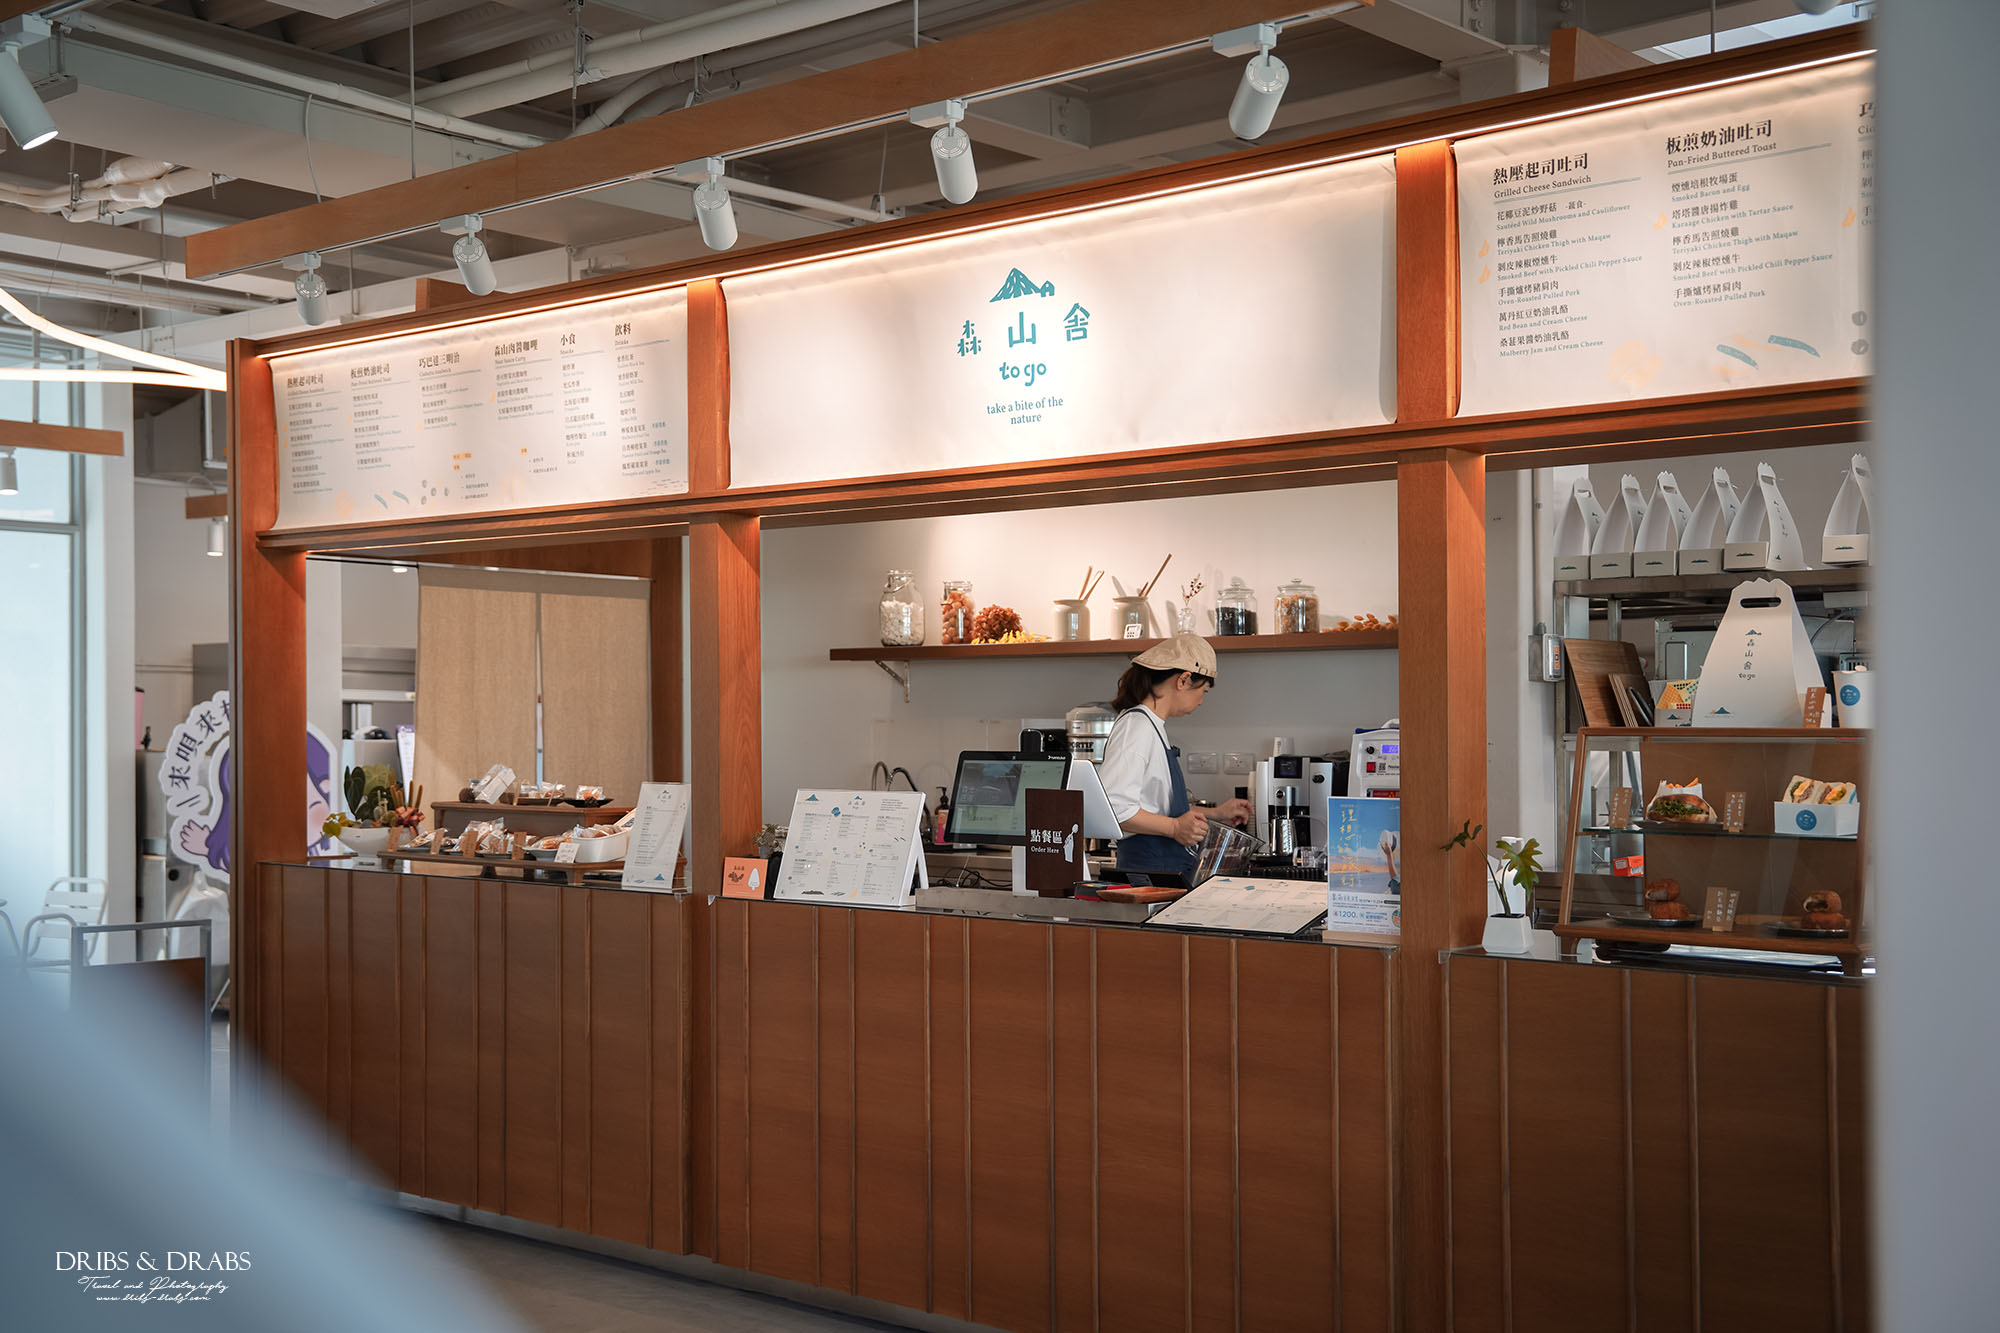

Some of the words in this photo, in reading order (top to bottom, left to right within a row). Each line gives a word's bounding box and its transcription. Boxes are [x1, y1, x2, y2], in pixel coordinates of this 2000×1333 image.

[1666, 120, 1772, 155] 板煎奶油吐司
[1668, 153, 1709, 168] Pan-Fried
[1712, 146, 1750, 160] Buttered
[1752, 142, 1777, 152] Toast
[1493, 153, 1588, 185] 熱壓起司吐司
[1494, 187, 1521, 198] Grilled
[1523, 183, 1550, 194] Cheese
[1552, 175, 1592, 189] Sandwich
[1671, 172, 1738, 193] 煙燻培根牧場蛋
[1672, 192, 1698, 202] Smoked
[1700, 189, 1720, 198] Bacon
[1722, 186, 1735, 194] and
[1737, 184, 1750, 193] Egg
[1522, 218, 1537, 226] Wild
[1538, 213, 1576, 224] Mushrooms
[1592, 204, 1630, 215] Cauliflower
[1672, 218, 1699, 228] Karaage
[1701, 213, 1729, 224] Chicken
[1731, 210, 1746, 219] with
[1748, 207, 1770, 217] Tartar
[1773, 204, 1793, 212] Sauce
[1497, 230, 1557, 248] 檸香馬告照燒雞
[1672, 227, 1739, 246] 檸香馬告照燒雞
[1672, 245, 1701, 255] Teriyaki
[1703, 241, 1731, 250] Chicken
[1733, 237, 1753, 246] Thigh
[1755, 234, 1771, 242] with
[1773, 230, 1798, 239] Maqaw
[1497, 247, 1523, 256] Teriyaki
[1524, 243, 1549, 252] Chicken
[1552, 240, 1569, 248] Thigh
[1498, 273, 1522, 281] Smoked
[1538, 267, 1554, 275] with
[1555, 264, 1578, 273] Pickled
[1580, 261, 1597, 269] Chili
[1598, 258, 1621, 267] Pepper
[1673, 272, 1700, 281] Smoked
[1702, 270, 1717, 278] Beef
[1719, 267, 1736, 276] with
[1738, 263, 1763, 273] Pickled
[1765, 260, 1783, 269] Chili
[1784, 257, 1810, 267] Pepper
[1812, 254, 1833, 262] Sauce
[1498, 295, 1542, 305] Oven-Roasted
[1543, 291, 1563, 299] Pulled
[1724, 292, 1747, 301] Pulled
[1749, 290, 1765, 298] Pork
[1499, 304, 1568, 322] 萬丹紅豆奶油乳酪
[1542, 317, 1563, 325] Cream
[1565, 314, 1587, 322] Cheese
[615, 322, 631, 336] 飲料
[957, 302, 1090, 357] 森山舍
[560, 332, 576, 346] 小食
[1500, 348, 1529, 358] Mulberry
[1530, 347, 1543, 355] Jam
[1558, 343, 1579, 351] Cream
[999, 362, 1020, 380] to
[1024, 363, 1047, 386] go
[987, 403, 1006, 414] take
[1015, 400, 1034, 411] bite
[1035, 398, 1046, 408] of
[1048, 396, 1064, 407] the
[1010, 414, 1042, 424] nature
[1030, 830, 1062, 843] 點餐區
